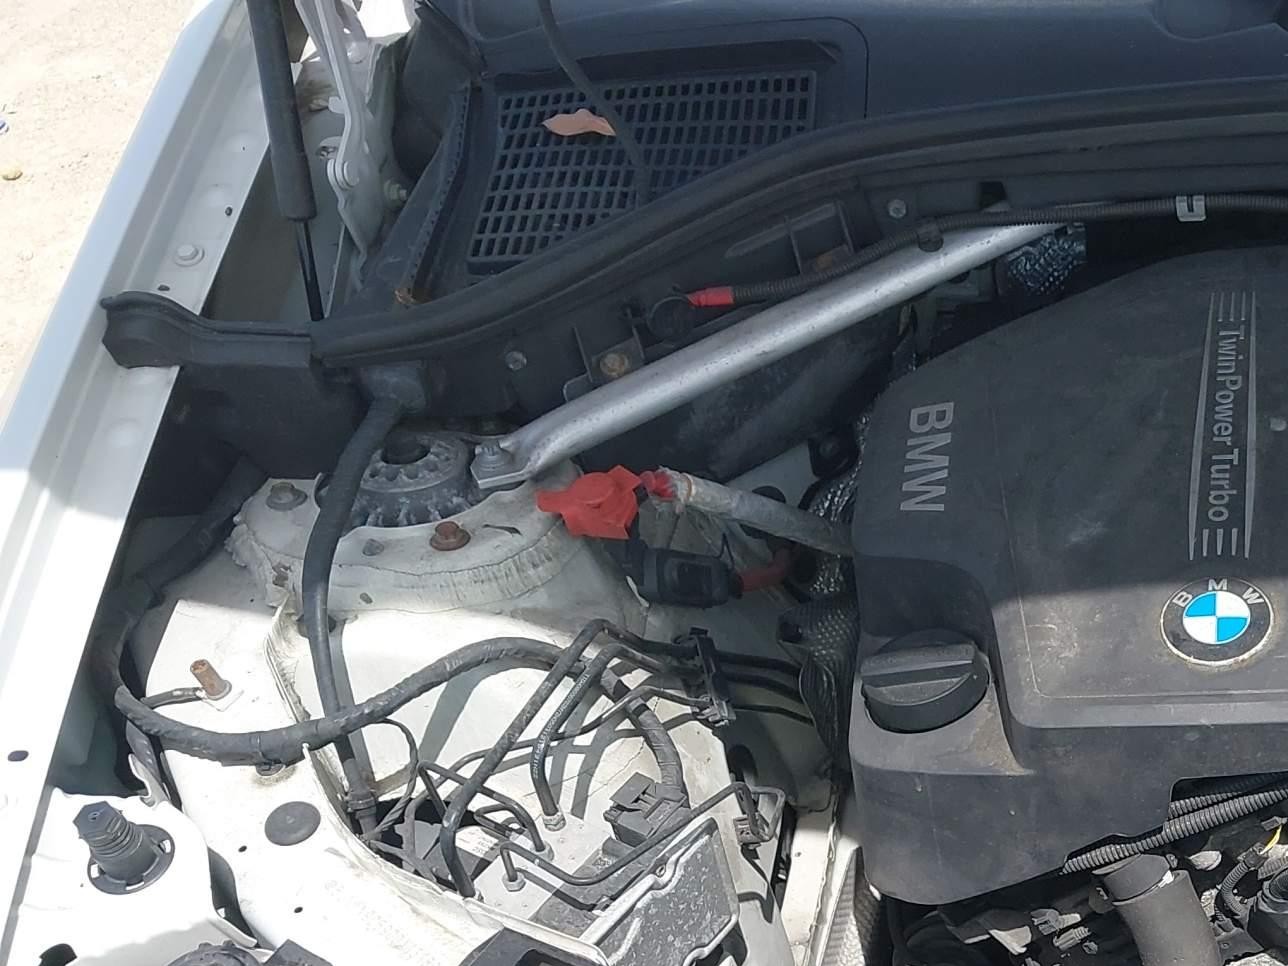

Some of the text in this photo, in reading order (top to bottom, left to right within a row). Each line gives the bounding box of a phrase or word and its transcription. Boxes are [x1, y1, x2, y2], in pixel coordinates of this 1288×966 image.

[900, 401, 954, 511] BMW
[1207, 324, 1245, 522] TwinPower Turbo
[1172, 578, 1264, 608] BMW
